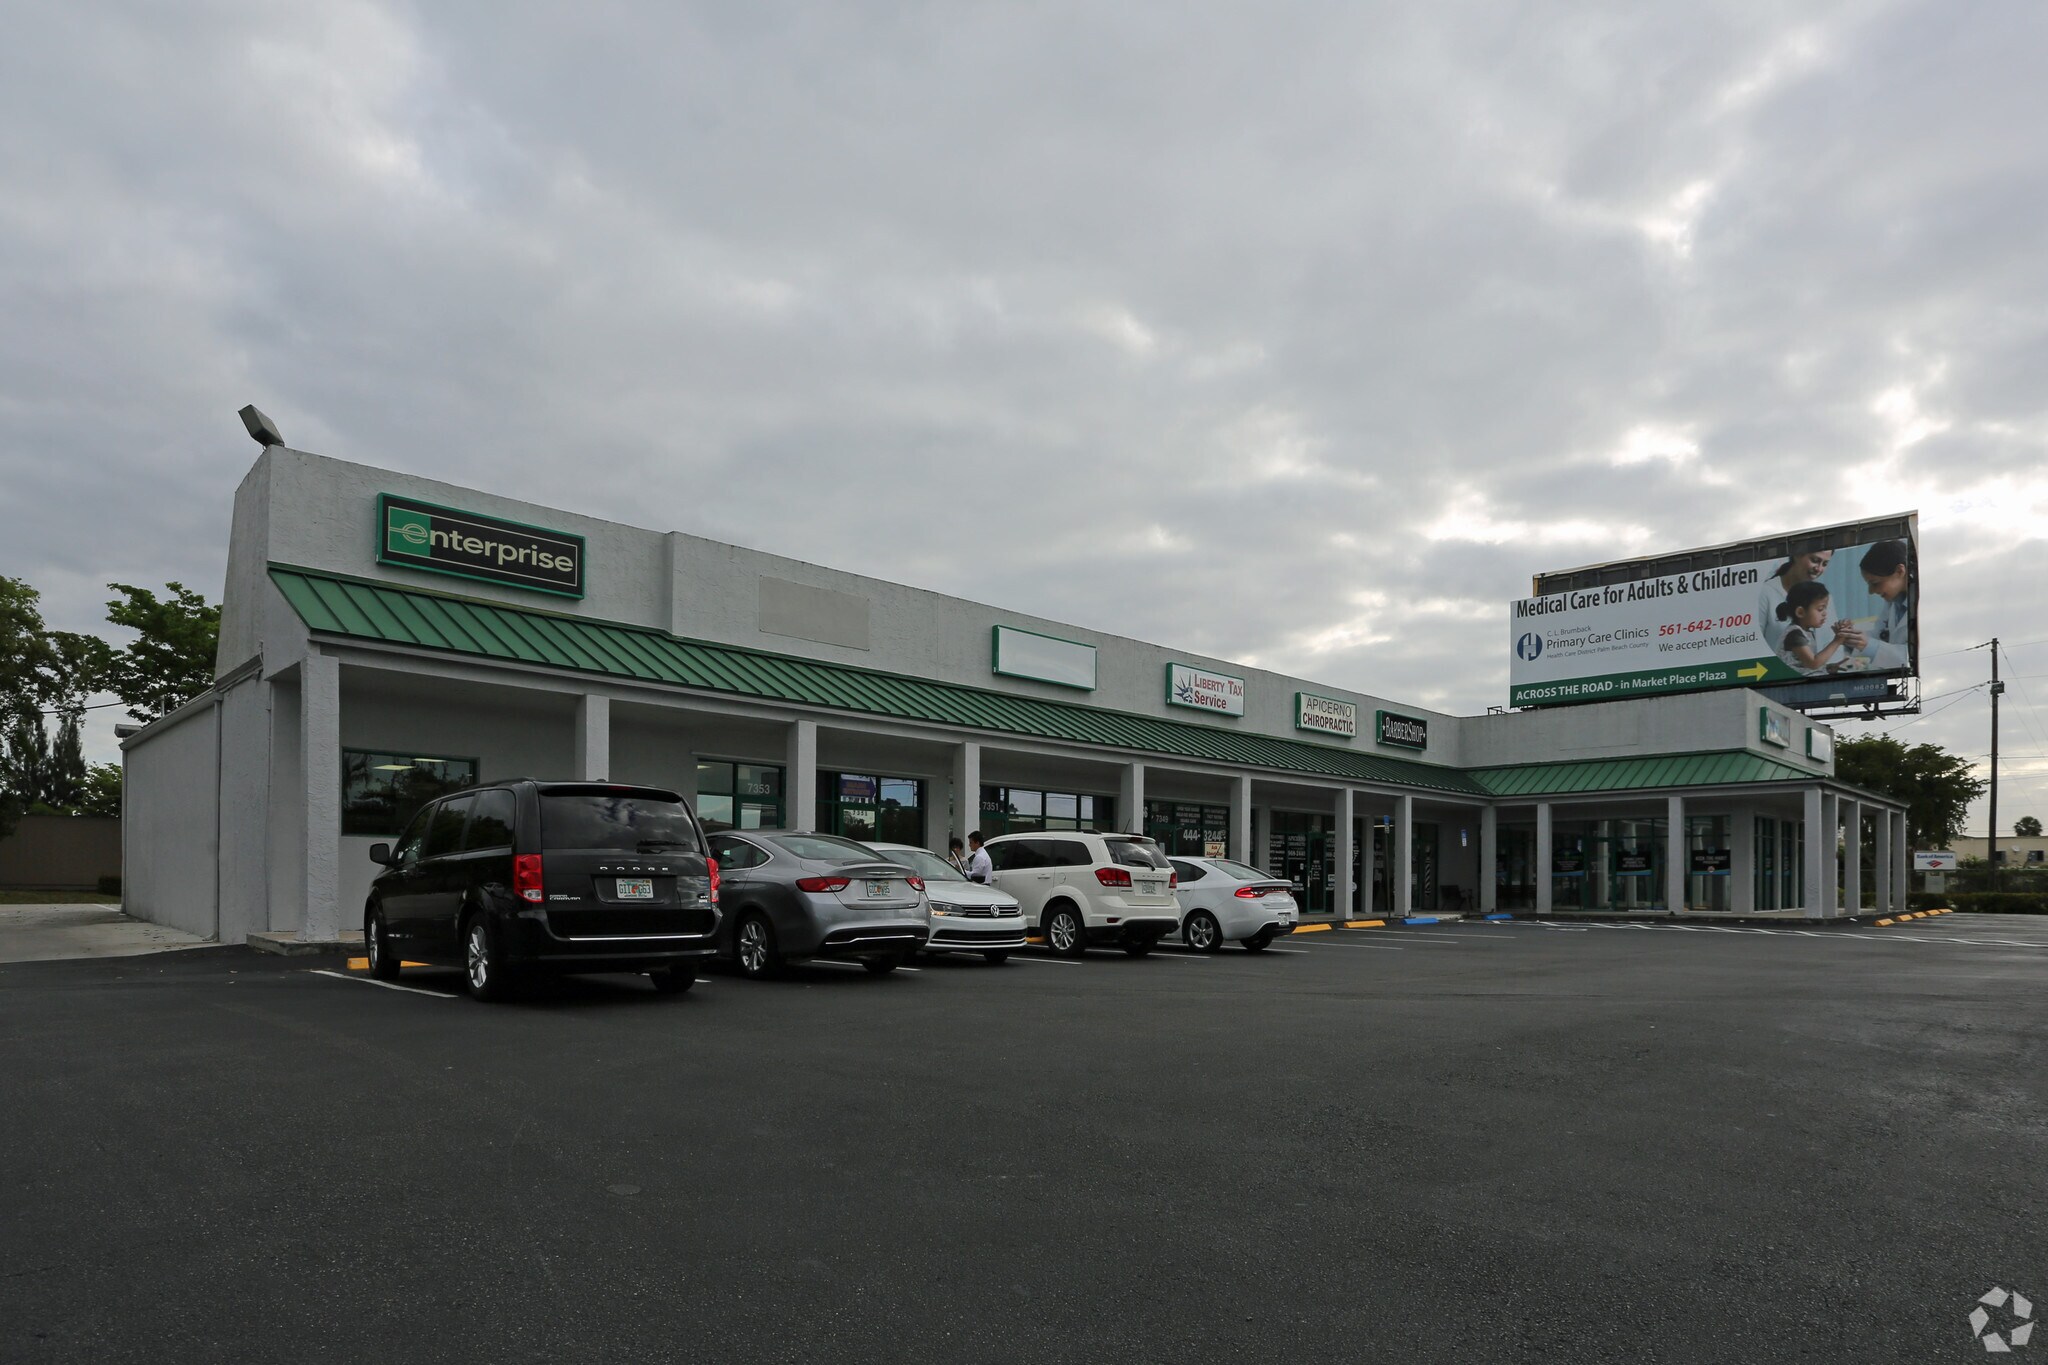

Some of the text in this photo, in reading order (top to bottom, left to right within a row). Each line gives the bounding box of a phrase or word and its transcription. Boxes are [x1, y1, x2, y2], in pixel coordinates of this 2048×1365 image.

[400, 523, 574, 572] enterprise
[1516, 567, 1758, 618] Medical Care for Adults & Children
[1560, 625, 1592, 636] Brumback
[1658, 613, 1751, 637] 561-642-1000
[1546, 628, 1649, 650] Primary Care Clinics
[1629, 642, 1649, 650] County
[1658, 632, 1758, 652] We accept Medicaid.
[1516, 688, 1556, 701] ACROSS
[1558, 684, 1579, 696] THE
[1582, 681, 1613, 694] ROAD
[1620, 680, 1630, 689] in
[1632, 677, 1667, 689] Market
[1669, 674, 1697, 684] Place
[1699, 671, 1727, 682] Plaza
[1194, 690, 1227, 709] Service
[1306, 697, 1352, 718] APICERNO
[1302, 712, 1354, 733] CHIROPRACTIC
[747, 783, 770, 795] 7353
[982, 801, 1000, 811] 7351
